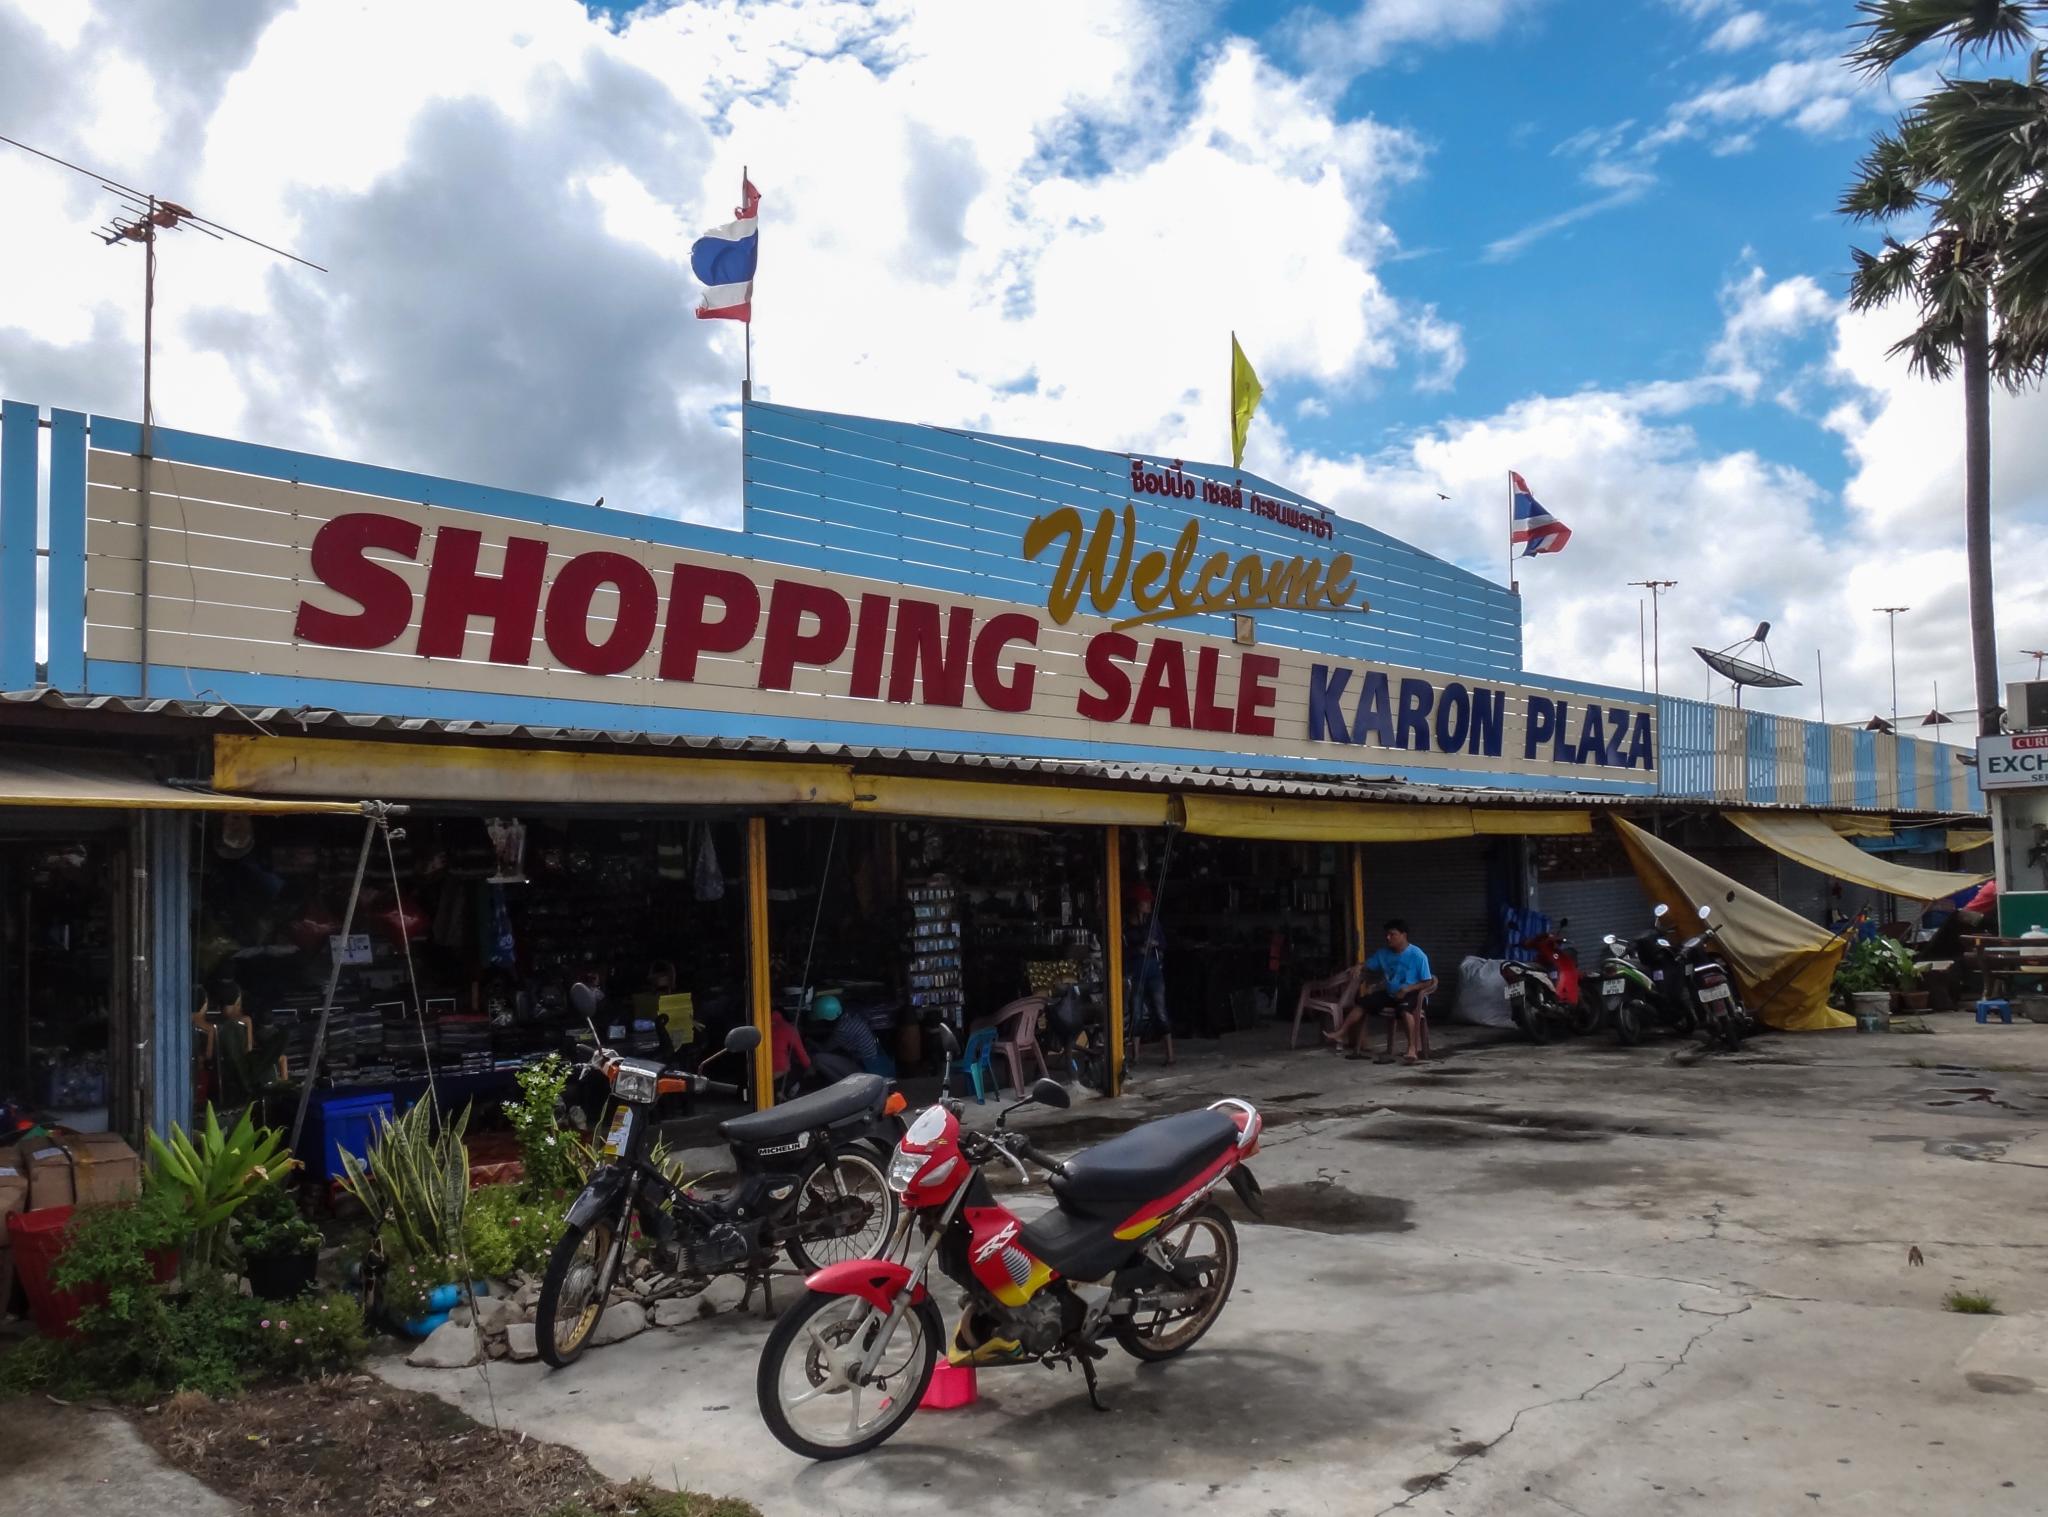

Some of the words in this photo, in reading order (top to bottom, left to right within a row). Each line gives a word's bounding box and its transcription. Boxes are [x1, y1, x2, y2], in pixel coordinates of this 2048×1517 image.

[293, 512, 1039, 712] SHOPPING
[1076, 631, 1281, 737] SALE
[1309, 663, 1505, 757] KARON
[1524, 695, 1653, 770] PLAZA
[1024, 504, 1357, 626] Welcome
